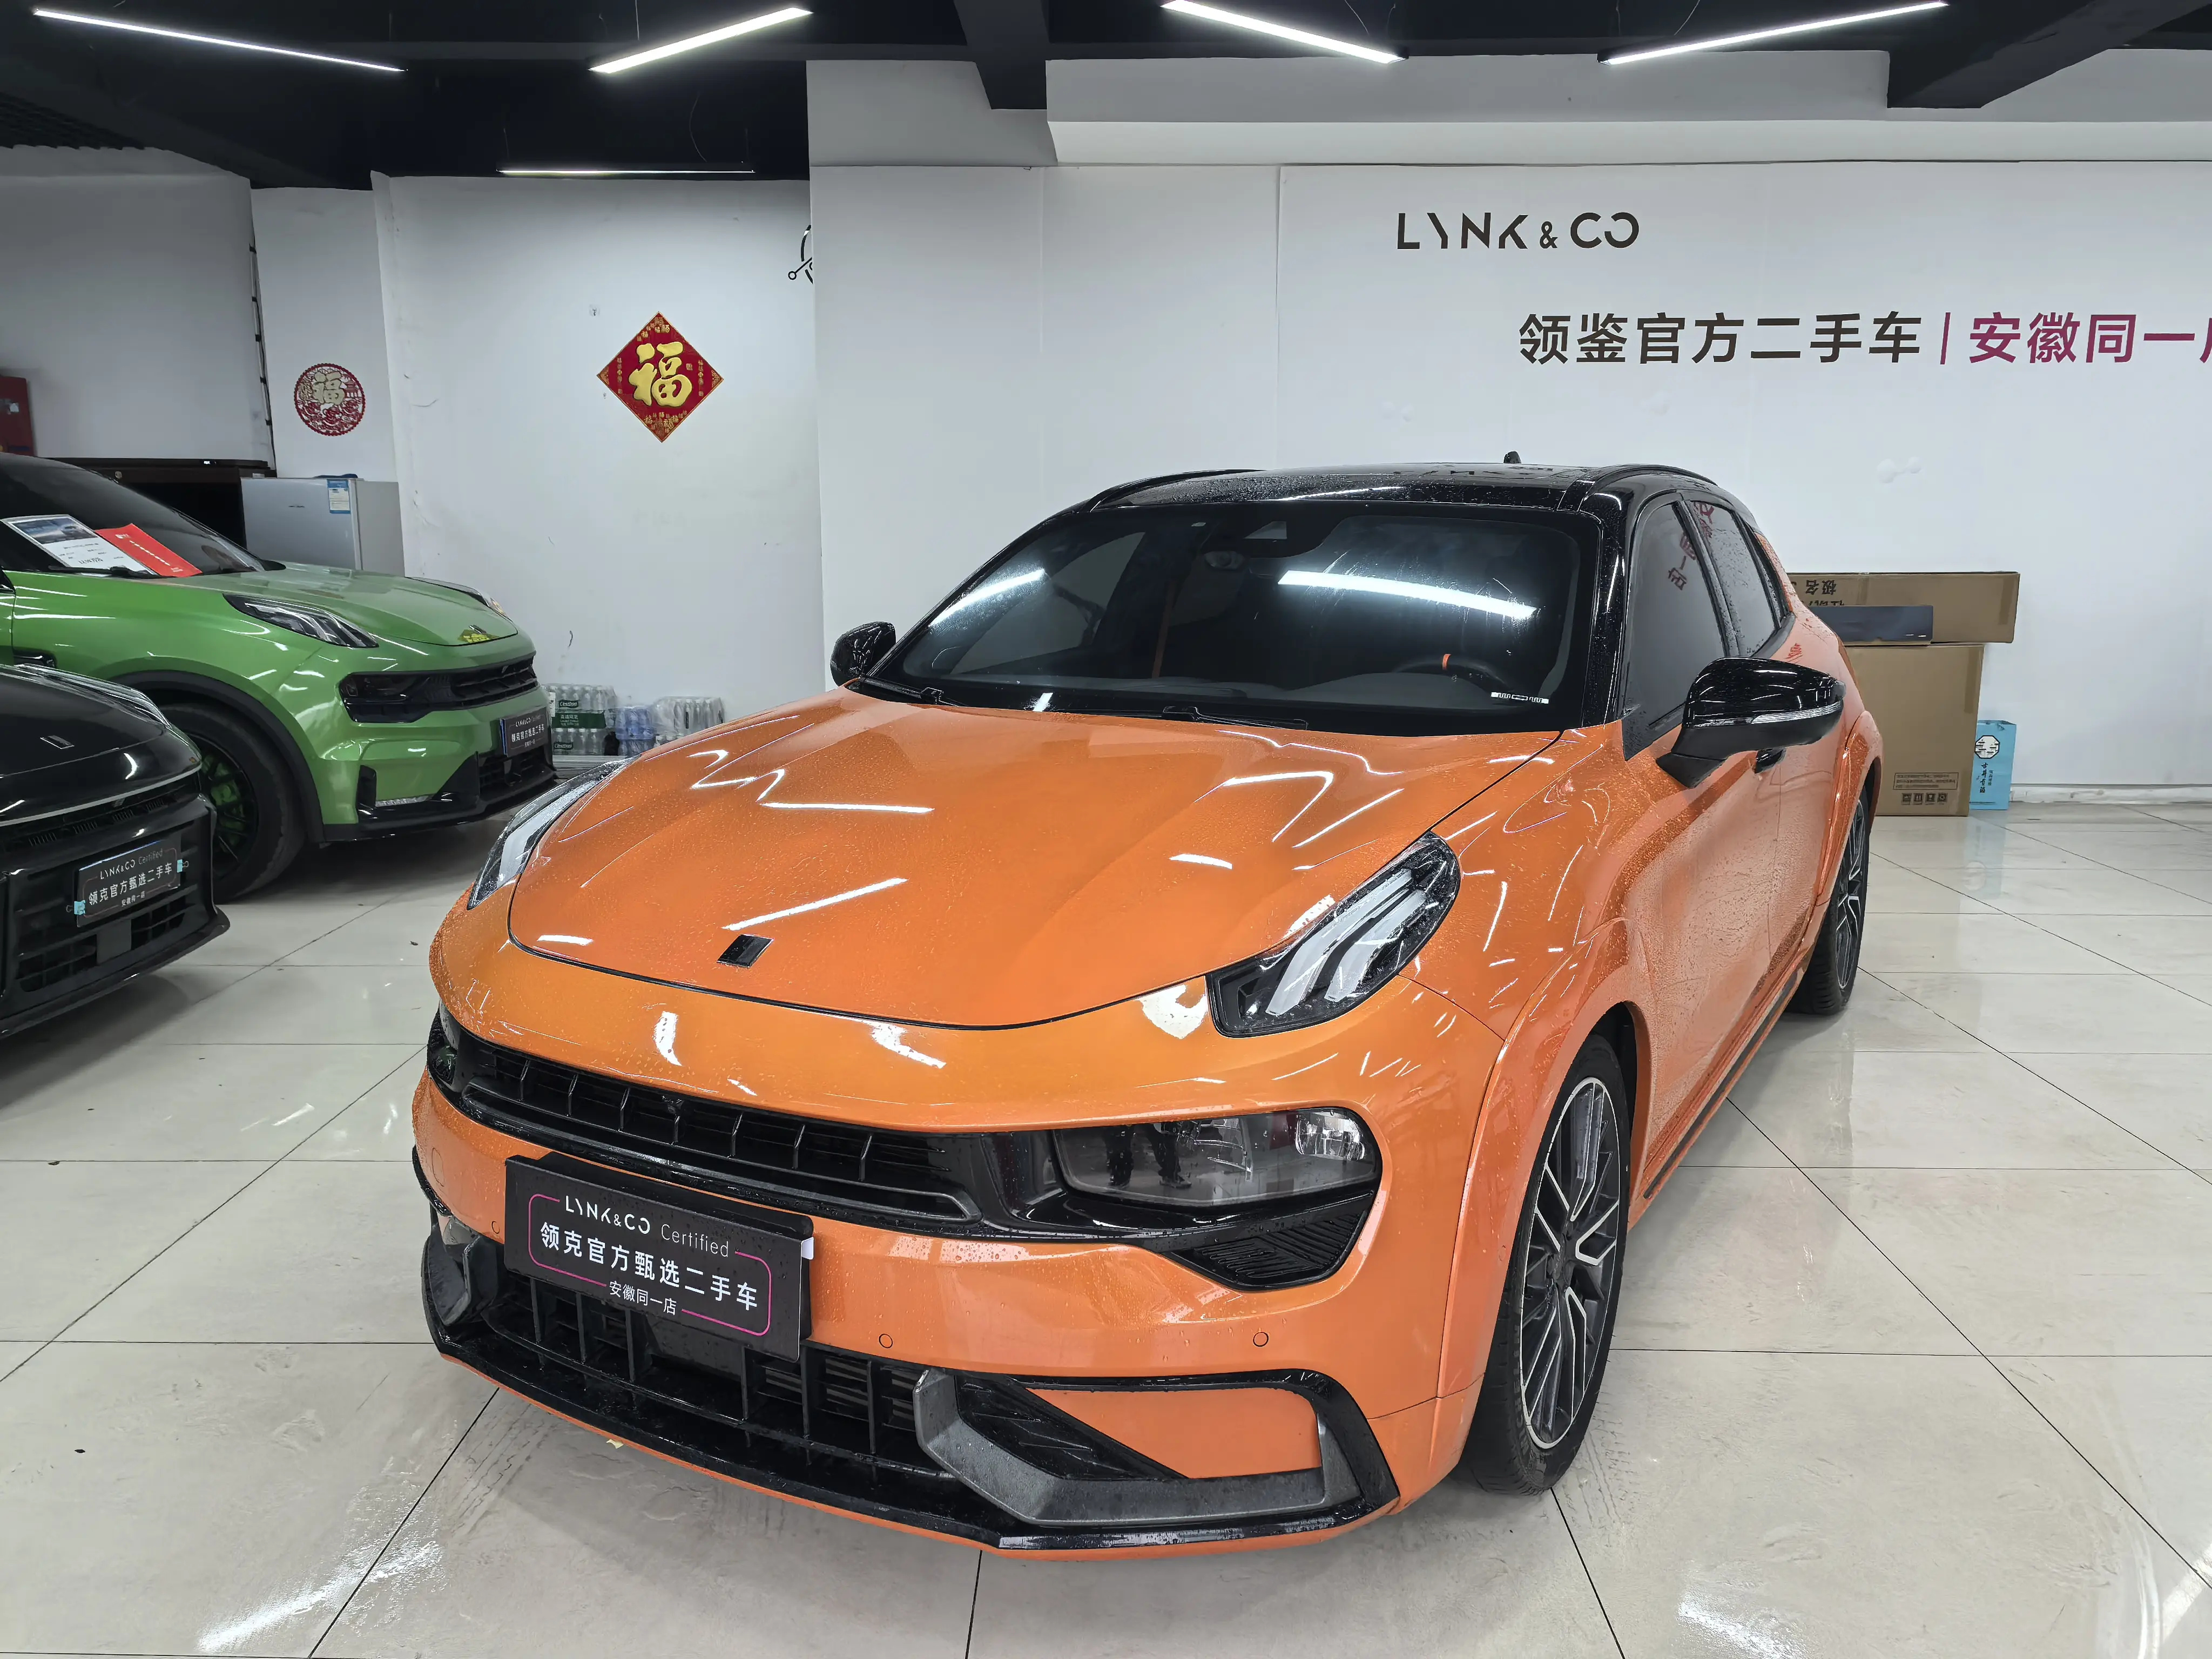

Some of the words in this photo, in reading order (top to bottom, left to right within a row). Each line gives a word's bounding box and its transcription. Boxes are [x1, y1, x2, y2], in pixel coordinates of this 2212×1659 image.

[1518, 311, 1921, 365] 领鉴官方二手车
[1969, 311, 2212, 363] 安徽同一
[628, 341, 692, 407] 福
[89, 862, 172, 906] 领克官方甄选二手车
[662, 1224, 729, 1258] Certified
[541, 1222, 757, 1311] 领克官方甄选二手车
[609, 1281, 677, 1316] 安徽同一店
